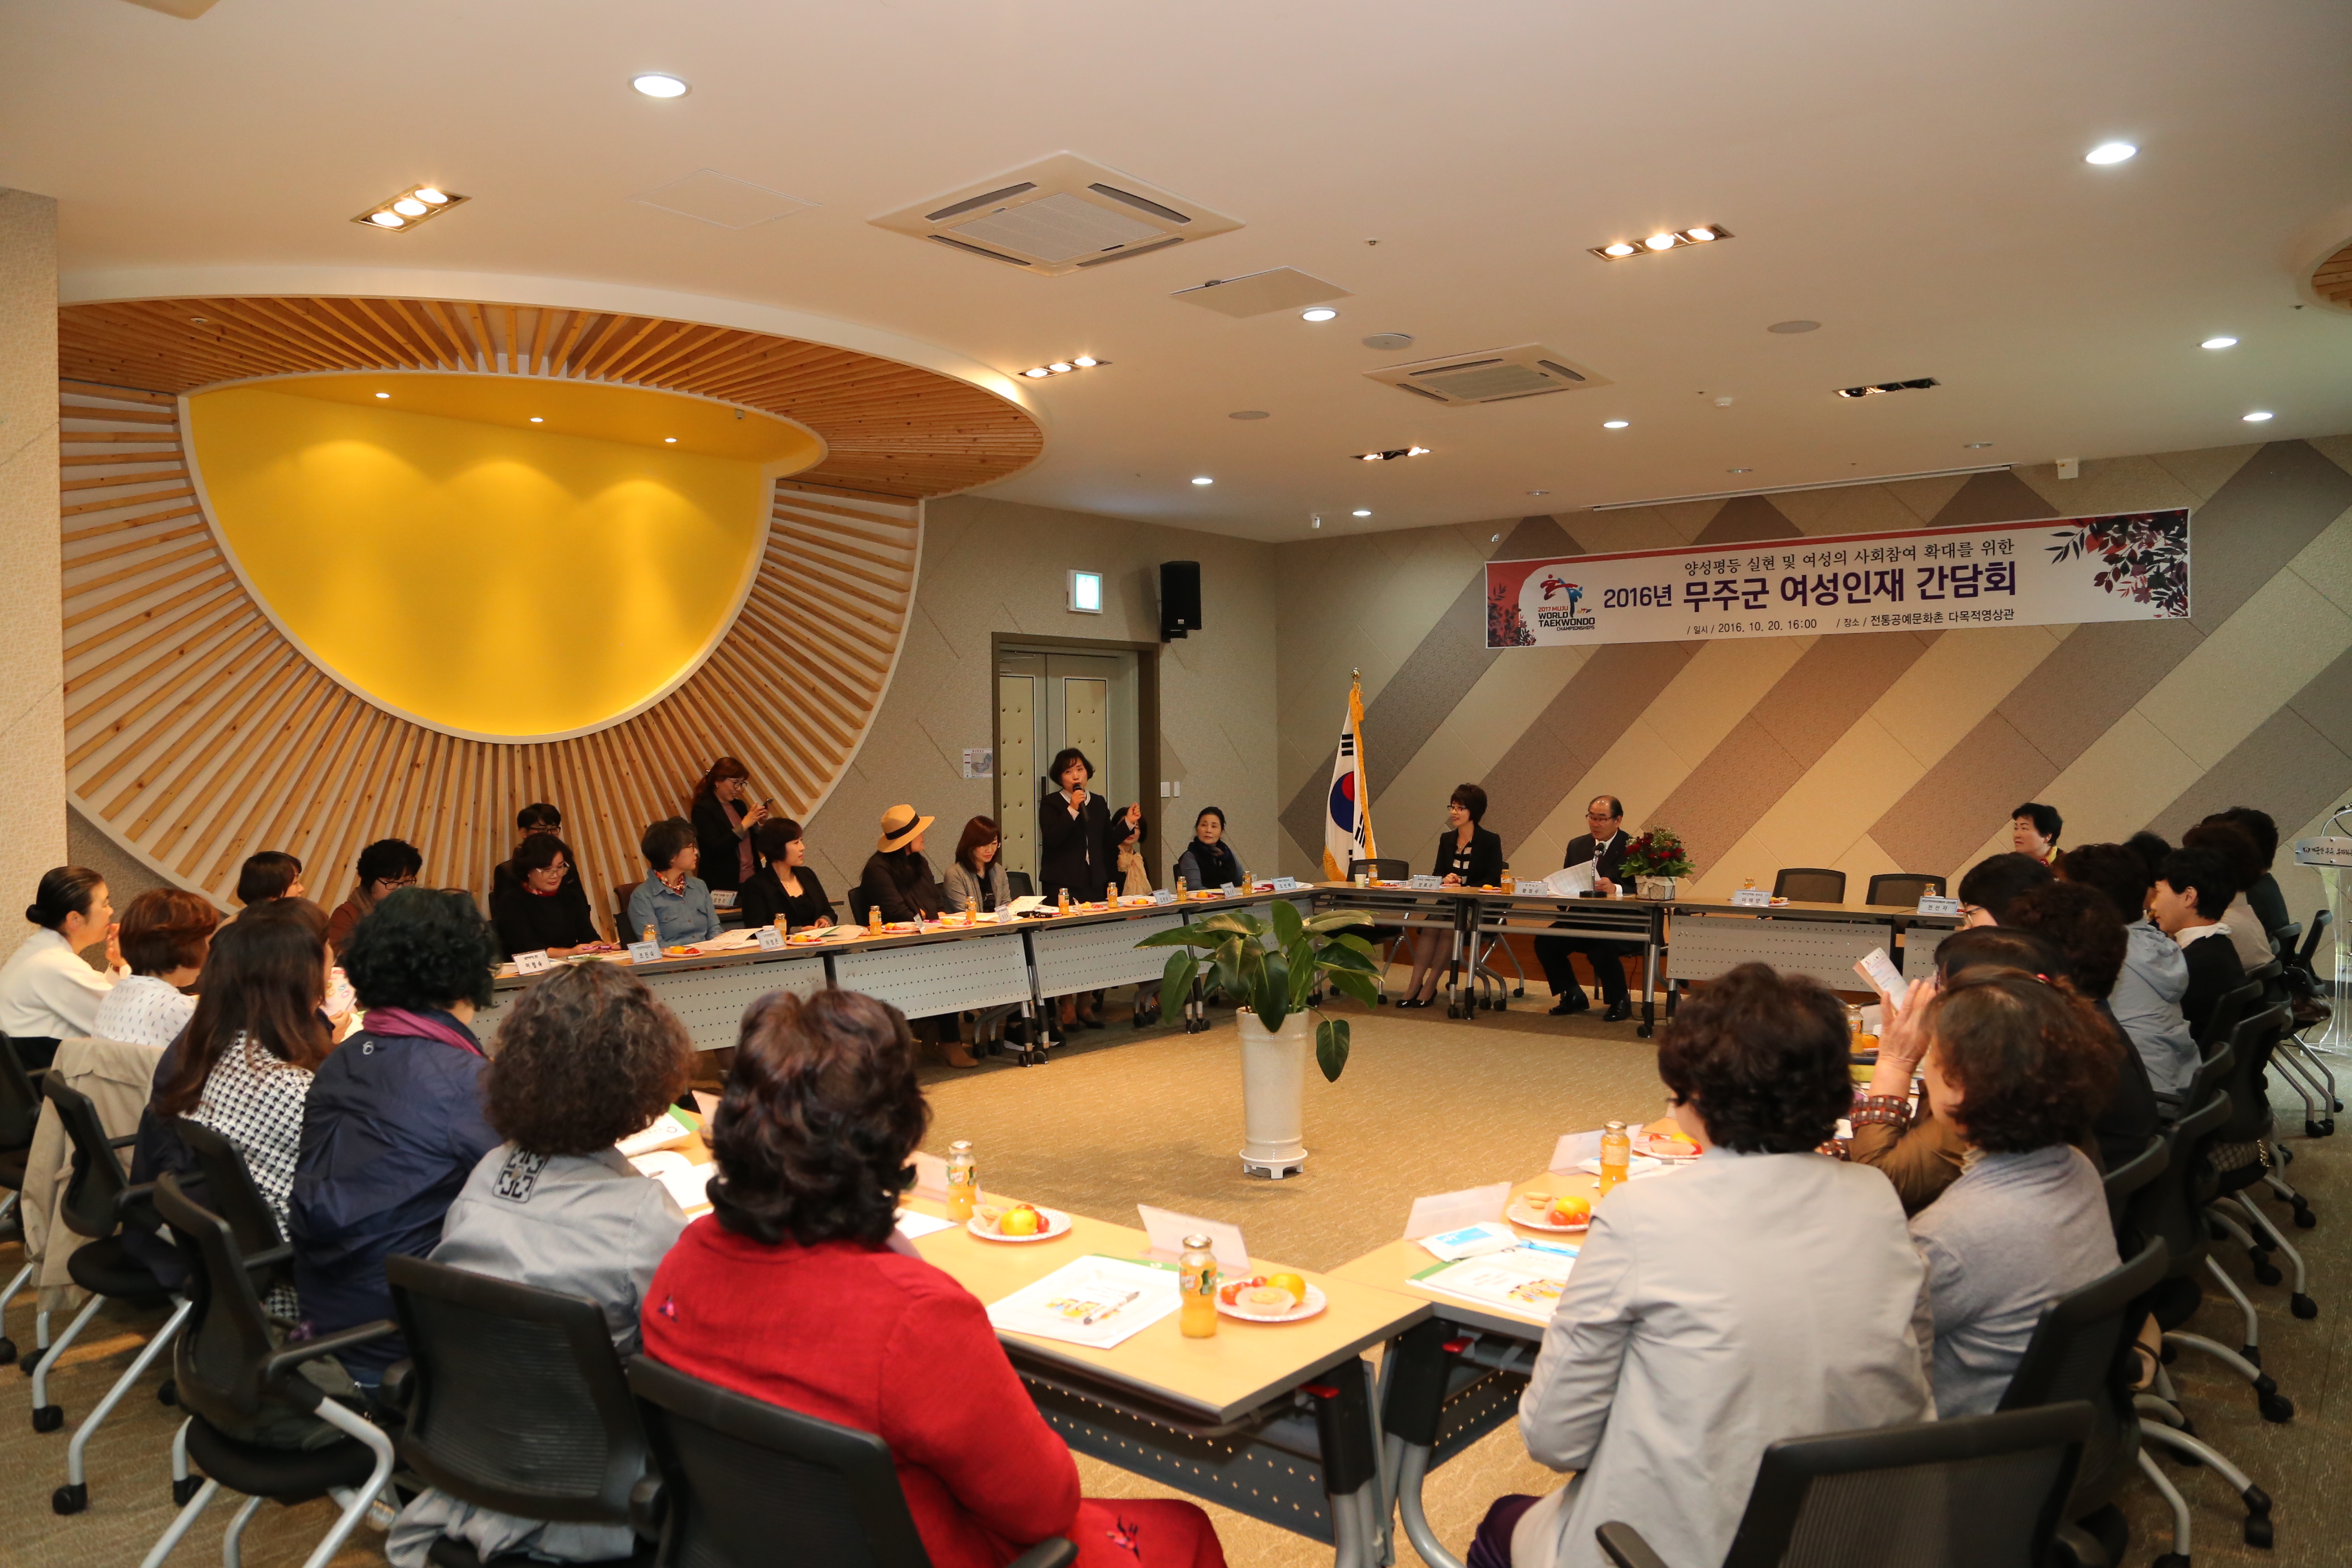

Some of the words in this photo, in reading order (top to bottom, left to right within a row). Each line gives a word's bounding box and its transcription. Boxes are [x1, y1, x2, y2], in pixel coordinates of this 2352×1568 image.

[1685, 558, 1741, 576] 양성평등
[1747, 555, 1775, 572] 실현
[1782, 554, 1796, 570] 및
[1803, 550, 1847, 568] 여성의
[1854, 545, 1916, 564] 사회참여
[1923, 542, 1974, 560] 확대를
[1981, 538, 2015, 556] 위한
[1603, 584, 1672, 608] 2016년
[1683, 578, 1769, 612] 무주군
[1780, 568, 1904, 607] 여성인재
[1916, 561, 2015, 600] 간담회
[1538, 617, 1596, 627] TAEKWONDO
[1694, 625, 1708, 634] 일시
[1718, 622, 1745, 632] 2016.
[1749, 622, 1763, 632] 10.
[1768, 621, 1783, 631] 20.
[1788, 619, 1817, 629] 16:00
[1844, 618, 1859, 627] 장소
[1870, 612, 1944, 626] 전통공예문화촌
[1948, 609, 2014, 623] 다목적영상관
